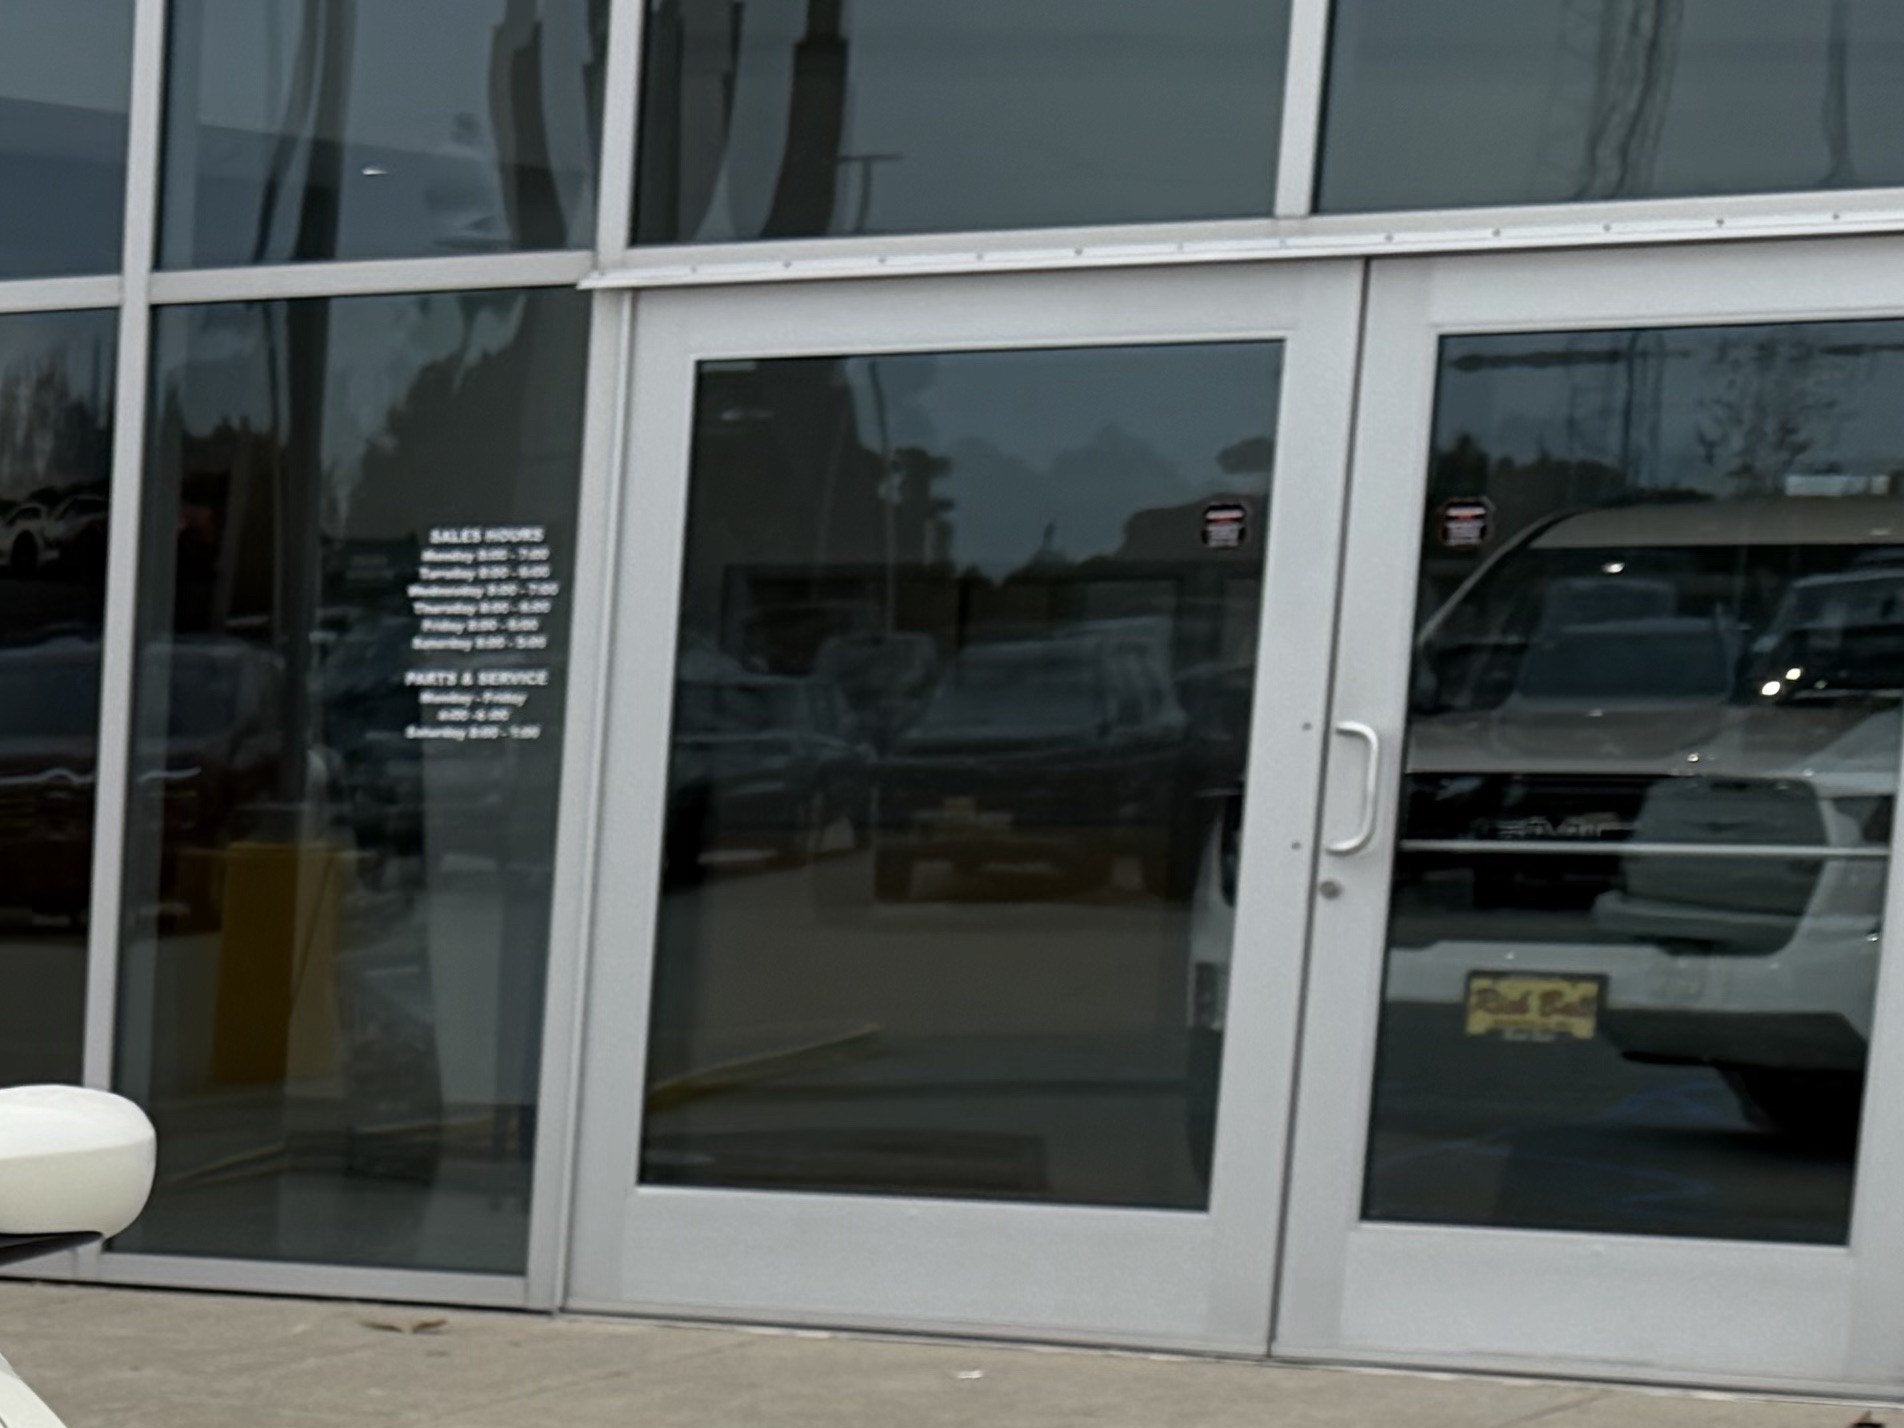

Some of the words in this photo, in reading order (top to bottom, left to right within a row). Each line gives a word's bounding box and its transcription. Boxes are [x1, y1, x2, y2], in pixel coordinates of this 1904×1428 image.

[429, 528, 482, 544] SALES
[484, 527, 545, 543] HOURS
[421, 548, 475, 564] Monday
[419, 566, 476, 582] Tuesday
[407, 583, 484, 599] Wednesday
[413, 601, 477, 616] Thursday
[421, 619, 465, 635] Friday
[412, 636, 473, 652] Saturday
[405, 671, 457, 686] PARTS
[461, 671, 474, 686] &
[477, 670, 549, 686] SERVICE
[419, 691, 474, 707] Monday
[482, 691, 528, 707] Friday
[405, 725, 467, 741] Saturday
